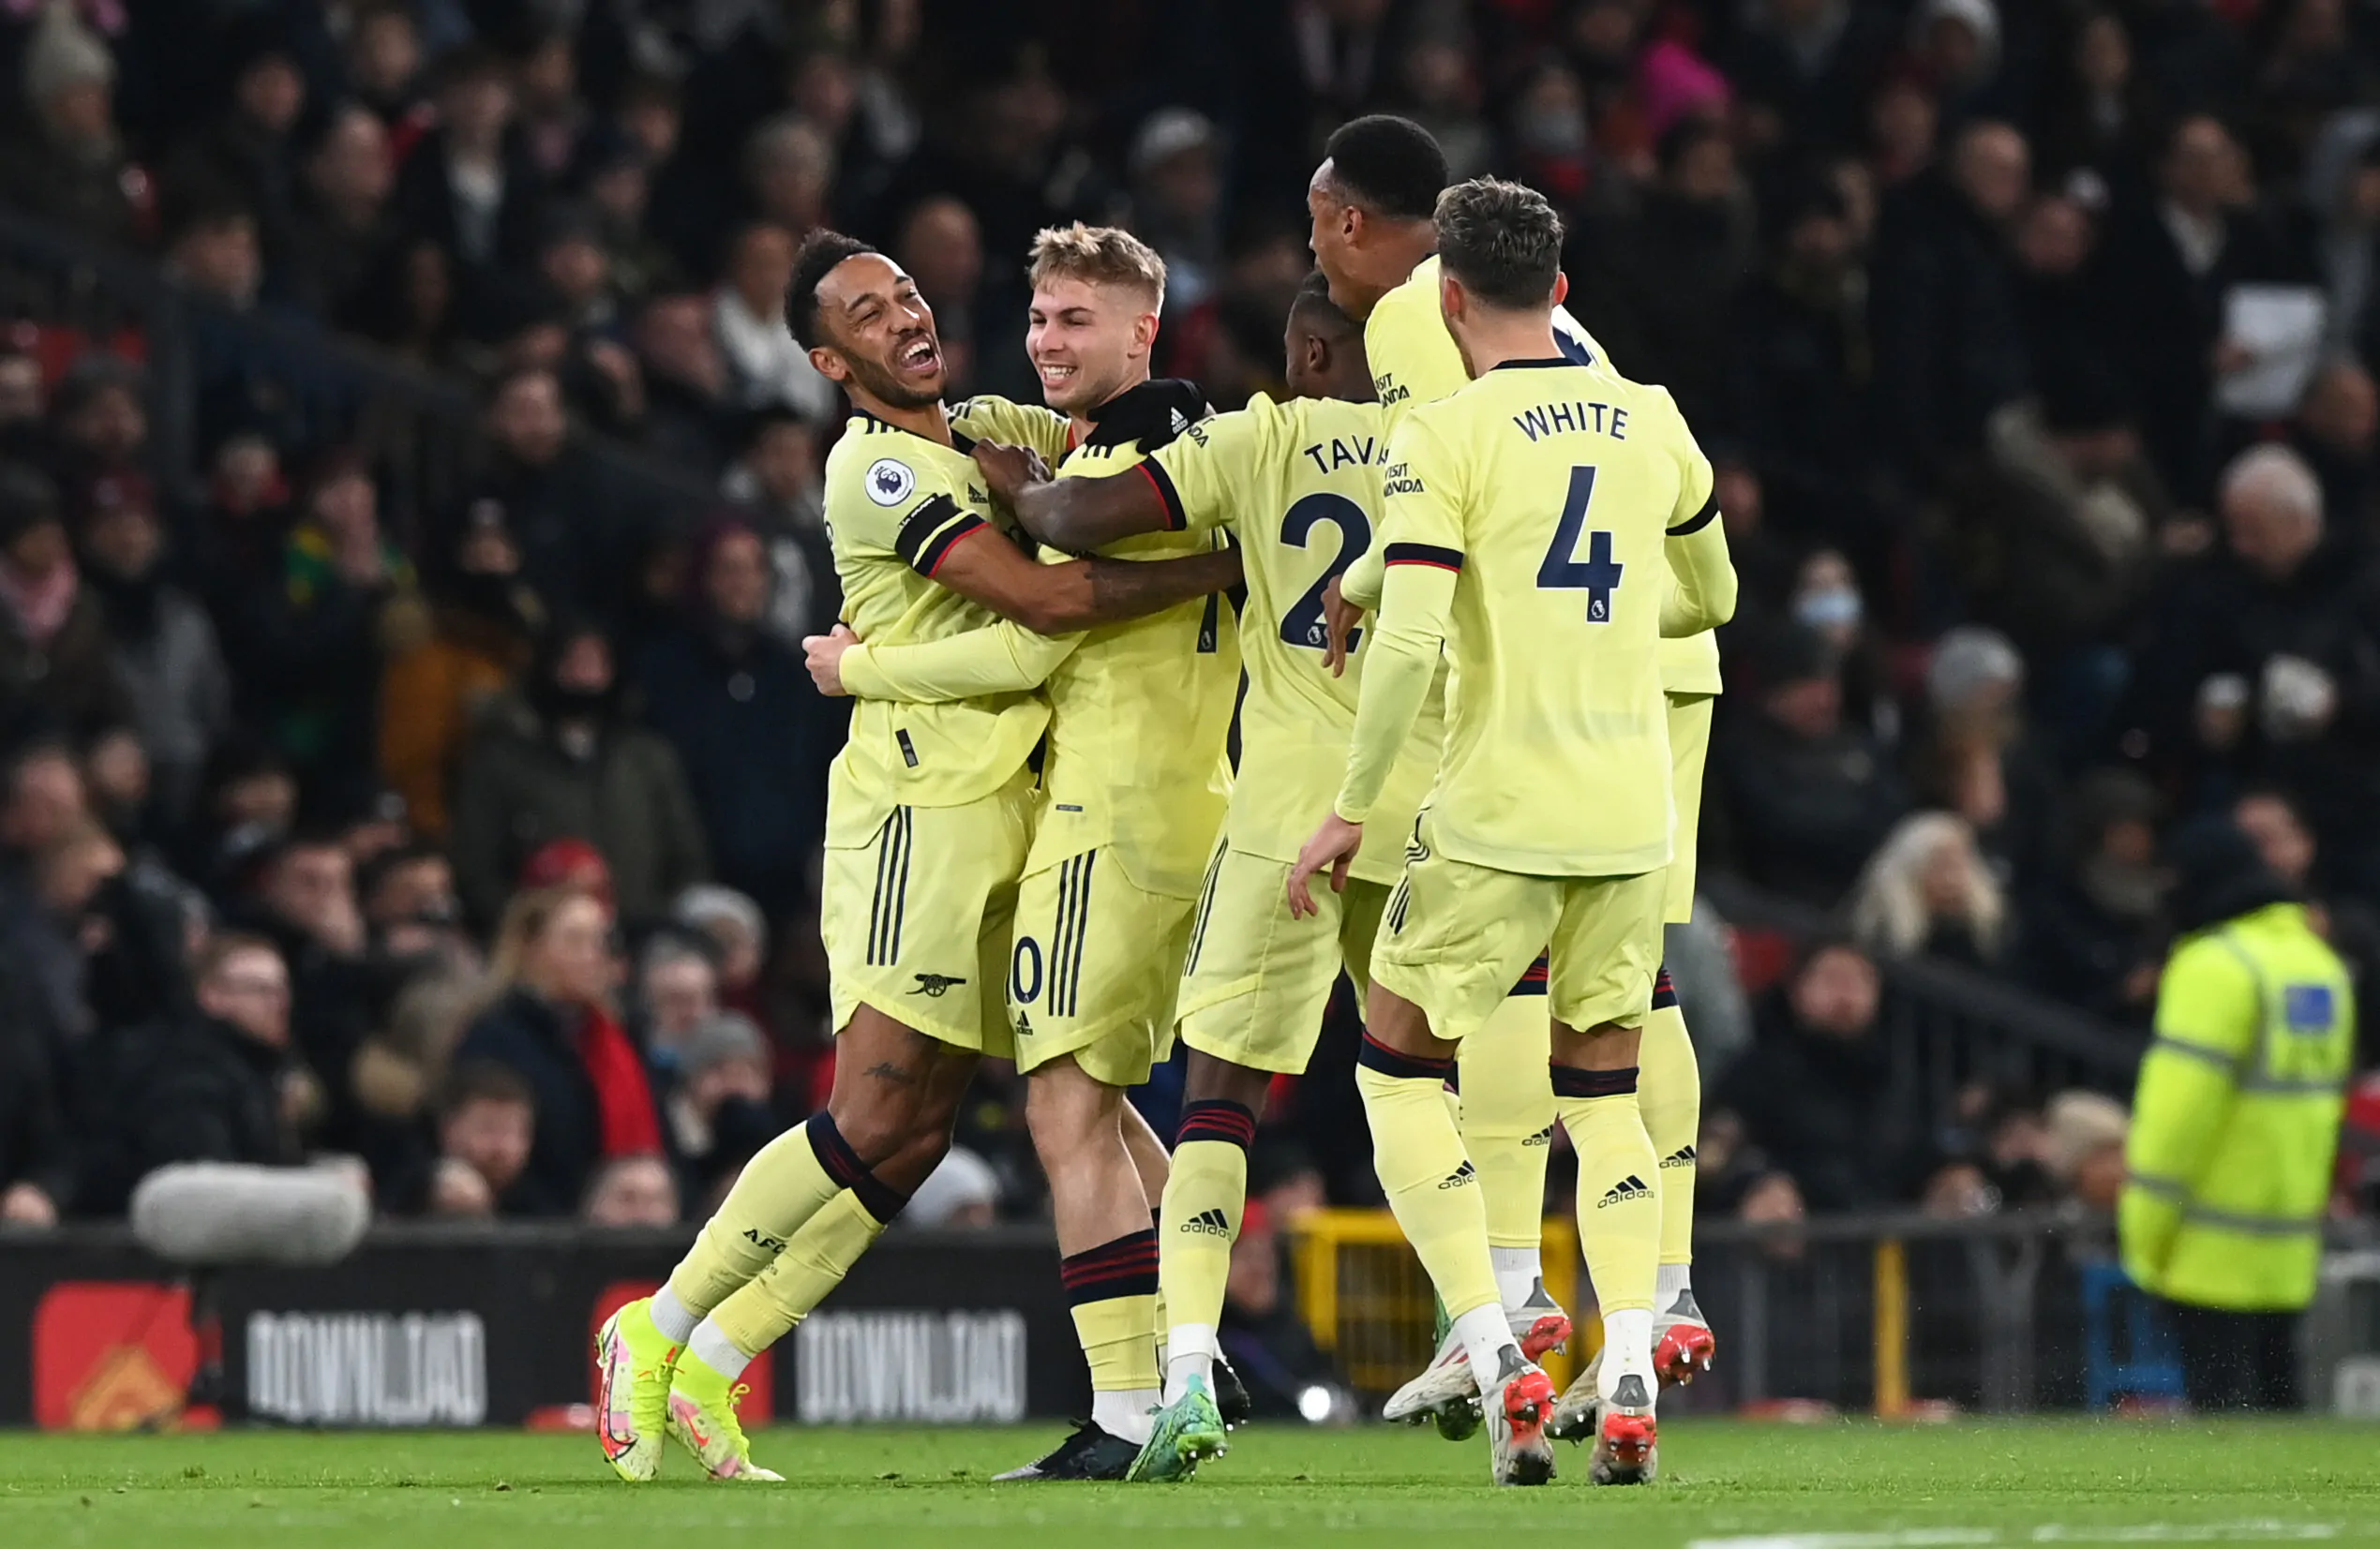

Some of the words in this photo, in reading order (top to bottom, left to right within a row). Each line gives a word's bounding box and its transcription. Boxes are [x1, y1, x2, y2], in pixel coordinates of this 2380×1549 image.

[1513, 402, 1628, 442] WHITE
[1280, 493, 1371, 653] 2
[1536, 466, 1624, 622] 4
[1597, 1189, 1654, 1209] adidas
